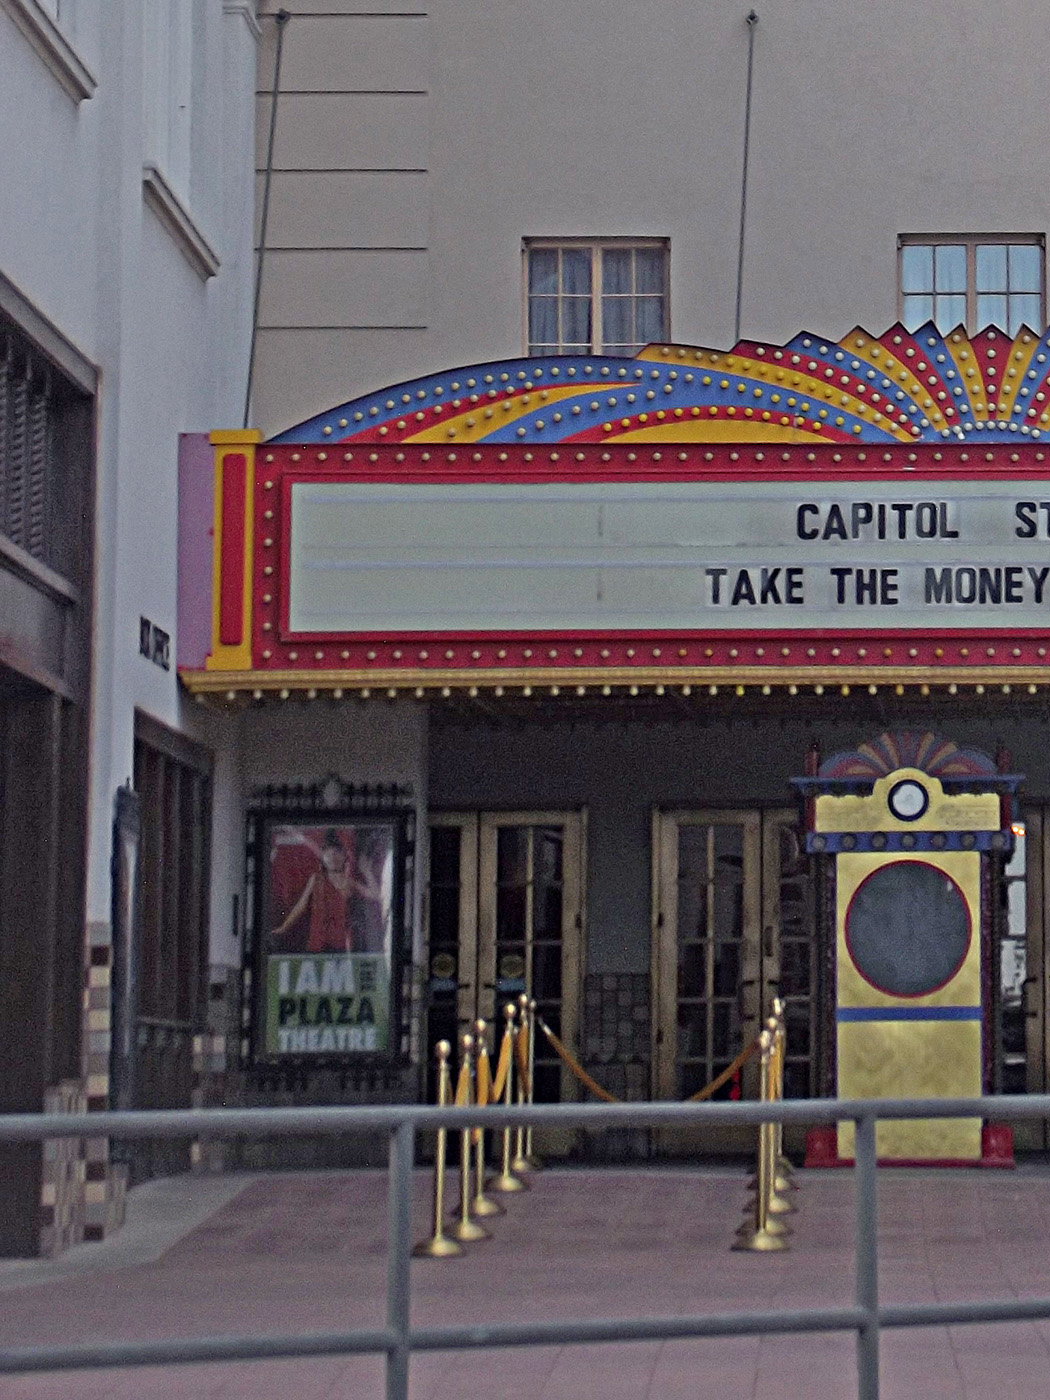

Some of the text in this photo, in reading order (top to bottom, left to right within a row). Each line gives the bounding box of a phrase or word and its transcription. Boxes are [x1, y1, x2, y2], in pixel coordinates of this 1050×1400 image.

[796, 502, 960, 541] CAPITOL
[704, 567, 805, 606] TAKE
[829, 567, 899, 606] THE
[923, 566, 1050, 604] MONEY
[278, 960, 291, 996] I
[295, 960, 355, 996] AM
[279, 996, 375, 1025] PLAZA
[278, 1027, 378, 1053] THEATRE
